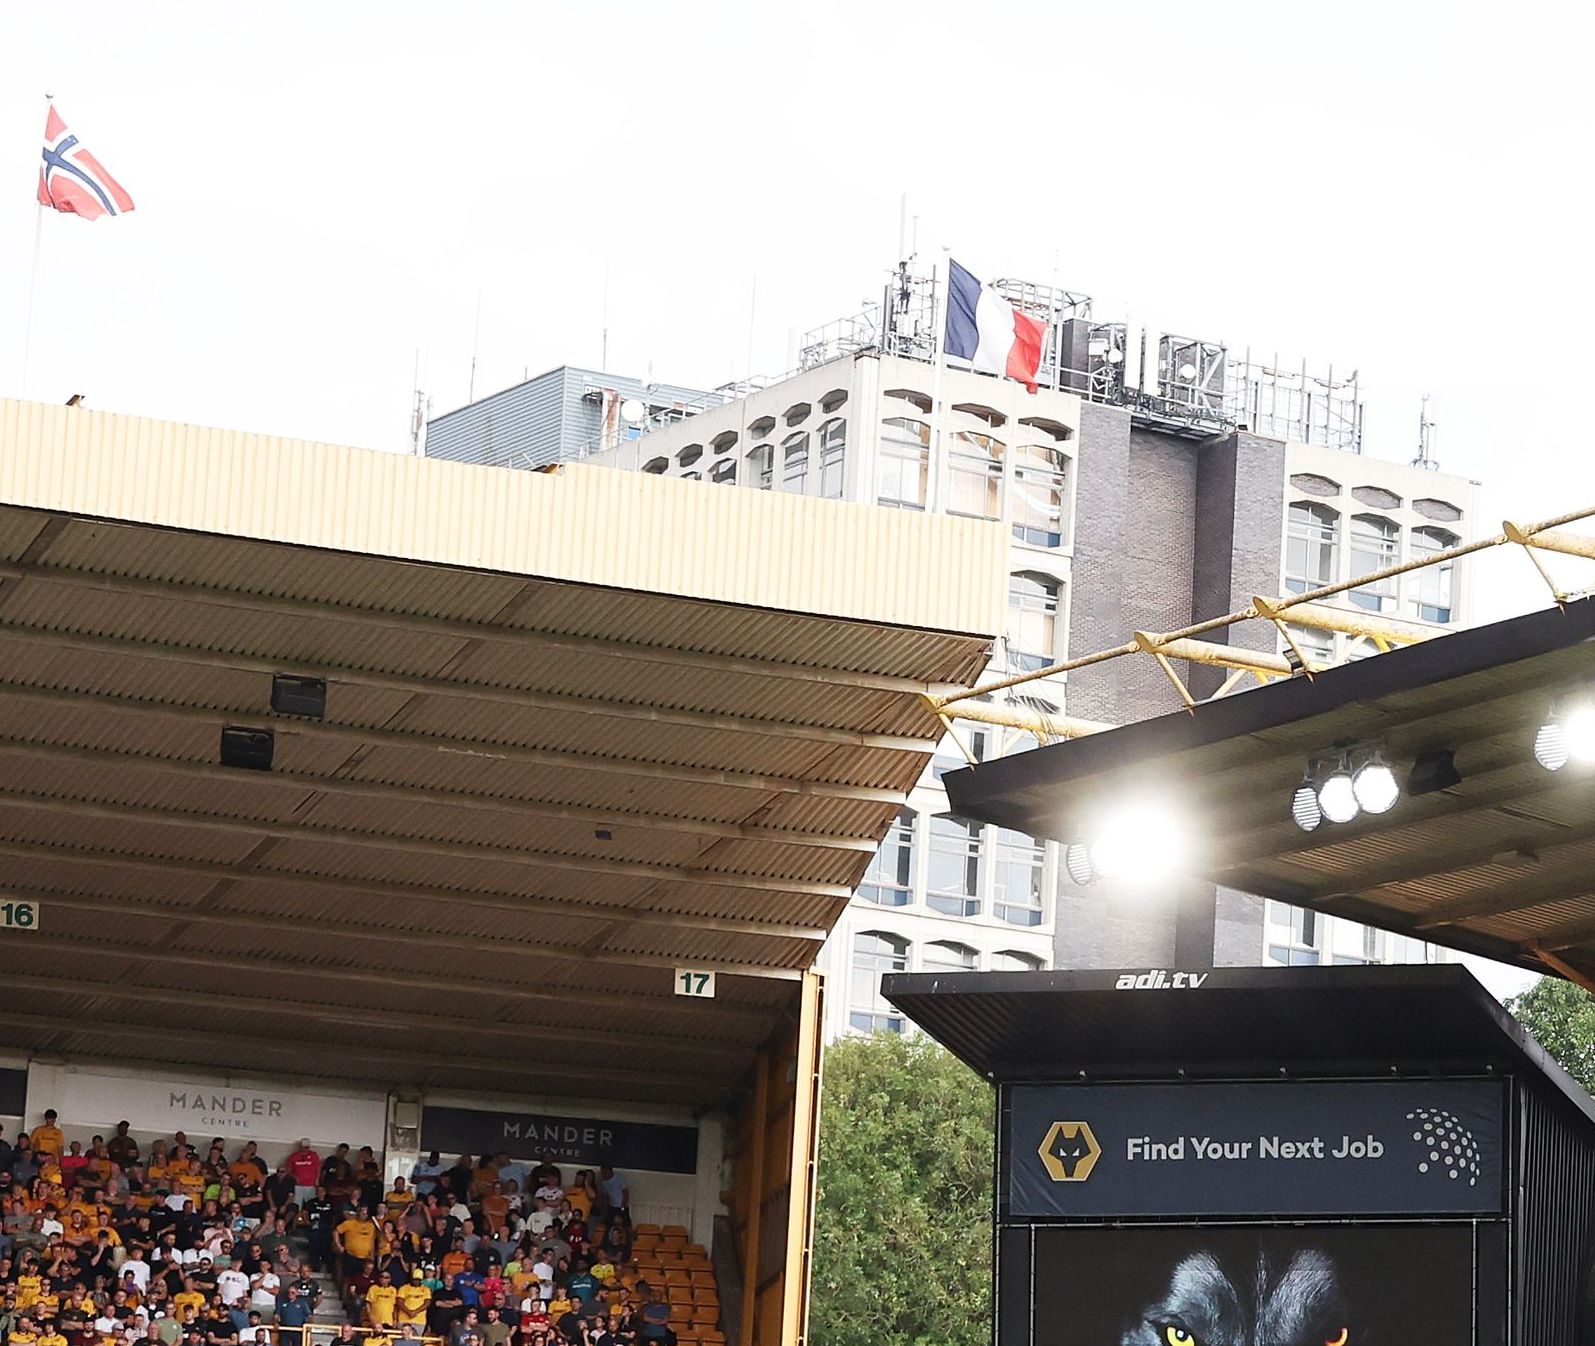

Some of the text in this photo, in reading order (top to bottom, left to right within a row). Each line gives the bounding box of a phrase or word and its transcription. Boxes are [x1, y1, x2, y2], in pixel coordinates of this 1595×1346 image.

[1, 902, 34, 927] 16
[680, 972, 710, 994] 17
[1115, 969, 1208, 990] adi.tv
[169, 1092, 282, 1117] MANDER
[503, 1121, 613, 1146] MANDER
[1126, 1134, 1384, 1160] Find Your Next Job
